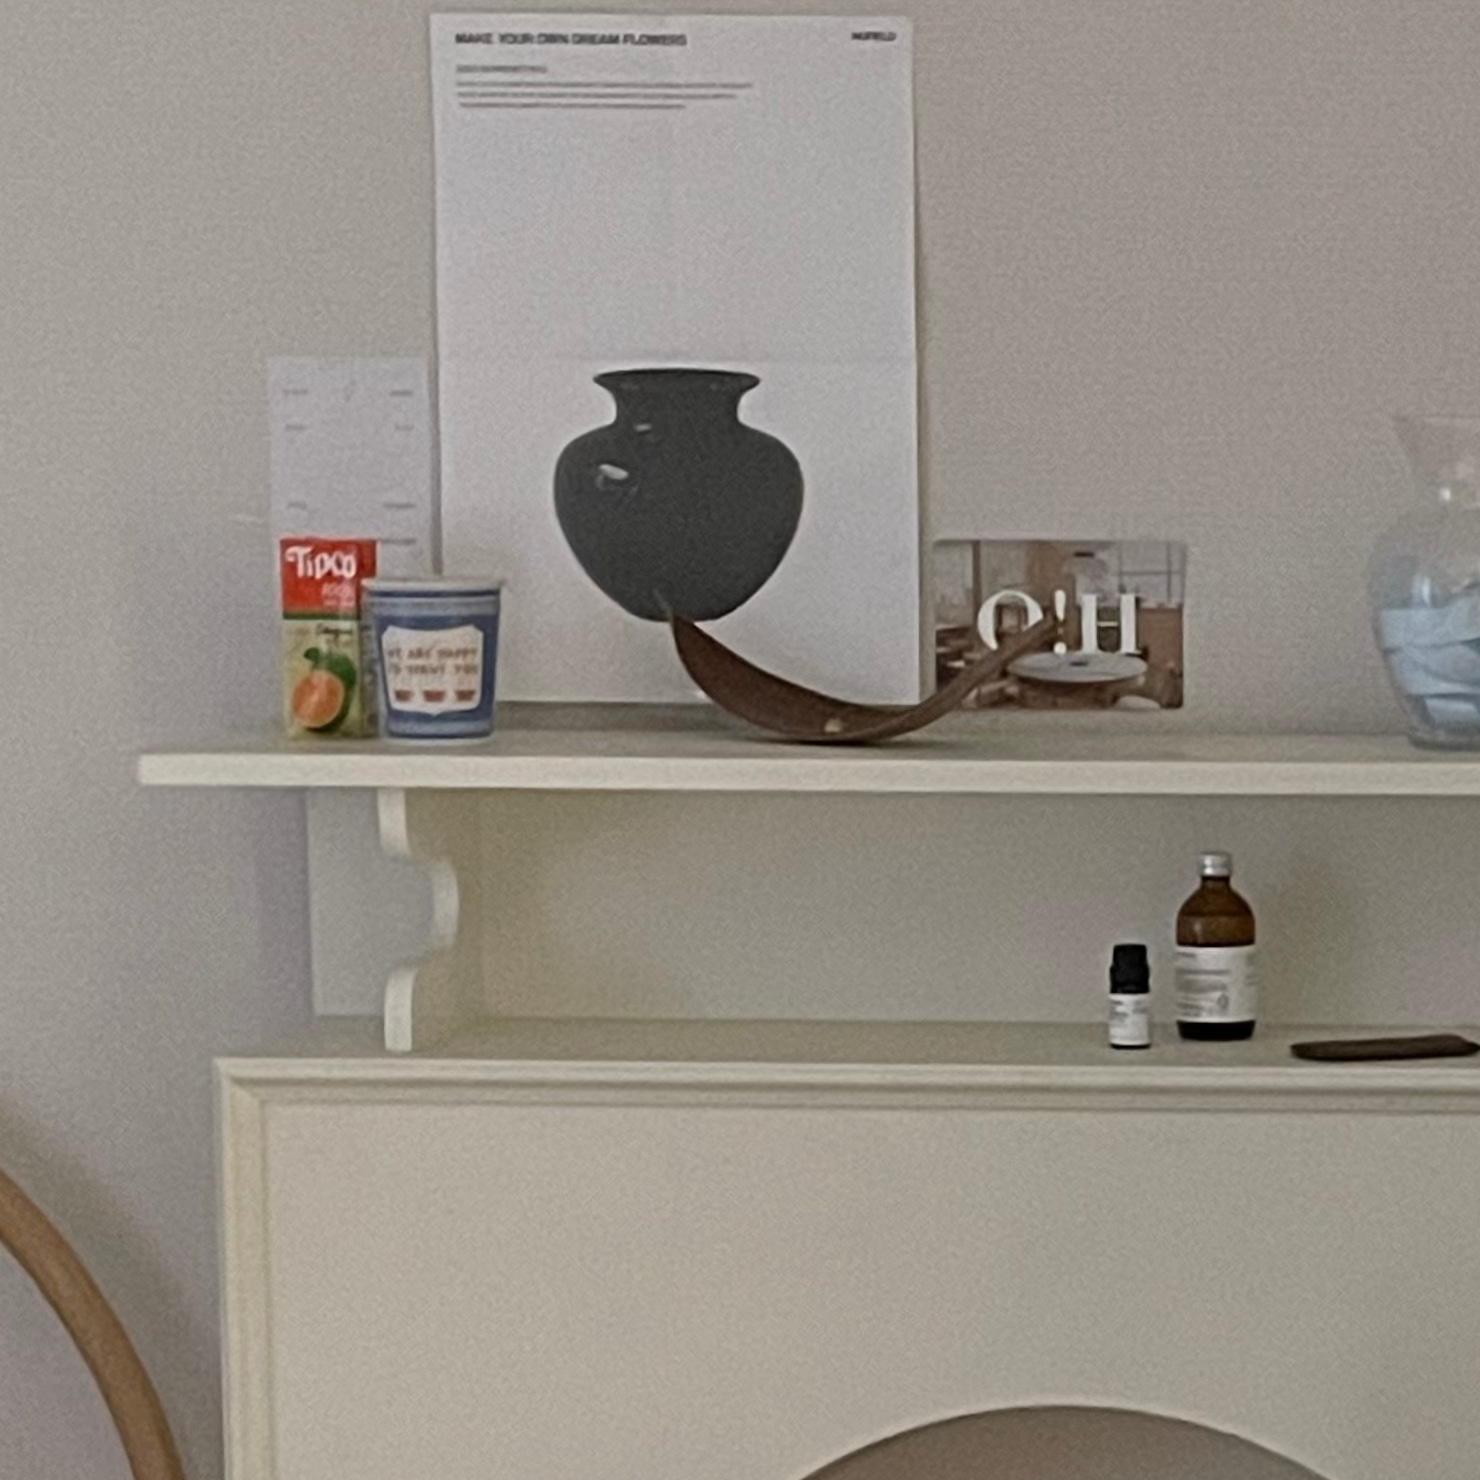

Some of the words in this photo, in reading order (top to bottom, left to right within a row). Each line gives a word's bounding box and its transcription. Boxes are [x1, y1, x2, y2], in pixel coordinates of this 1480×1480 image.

[455, 32, 494, 44] MAKE
[498, 32, 534, 45] YOUR
[537, 33, 569, 45] OWN
[572, 33, 620, 45] DREAM
[623, 33, 688, 46] FLOWERS
